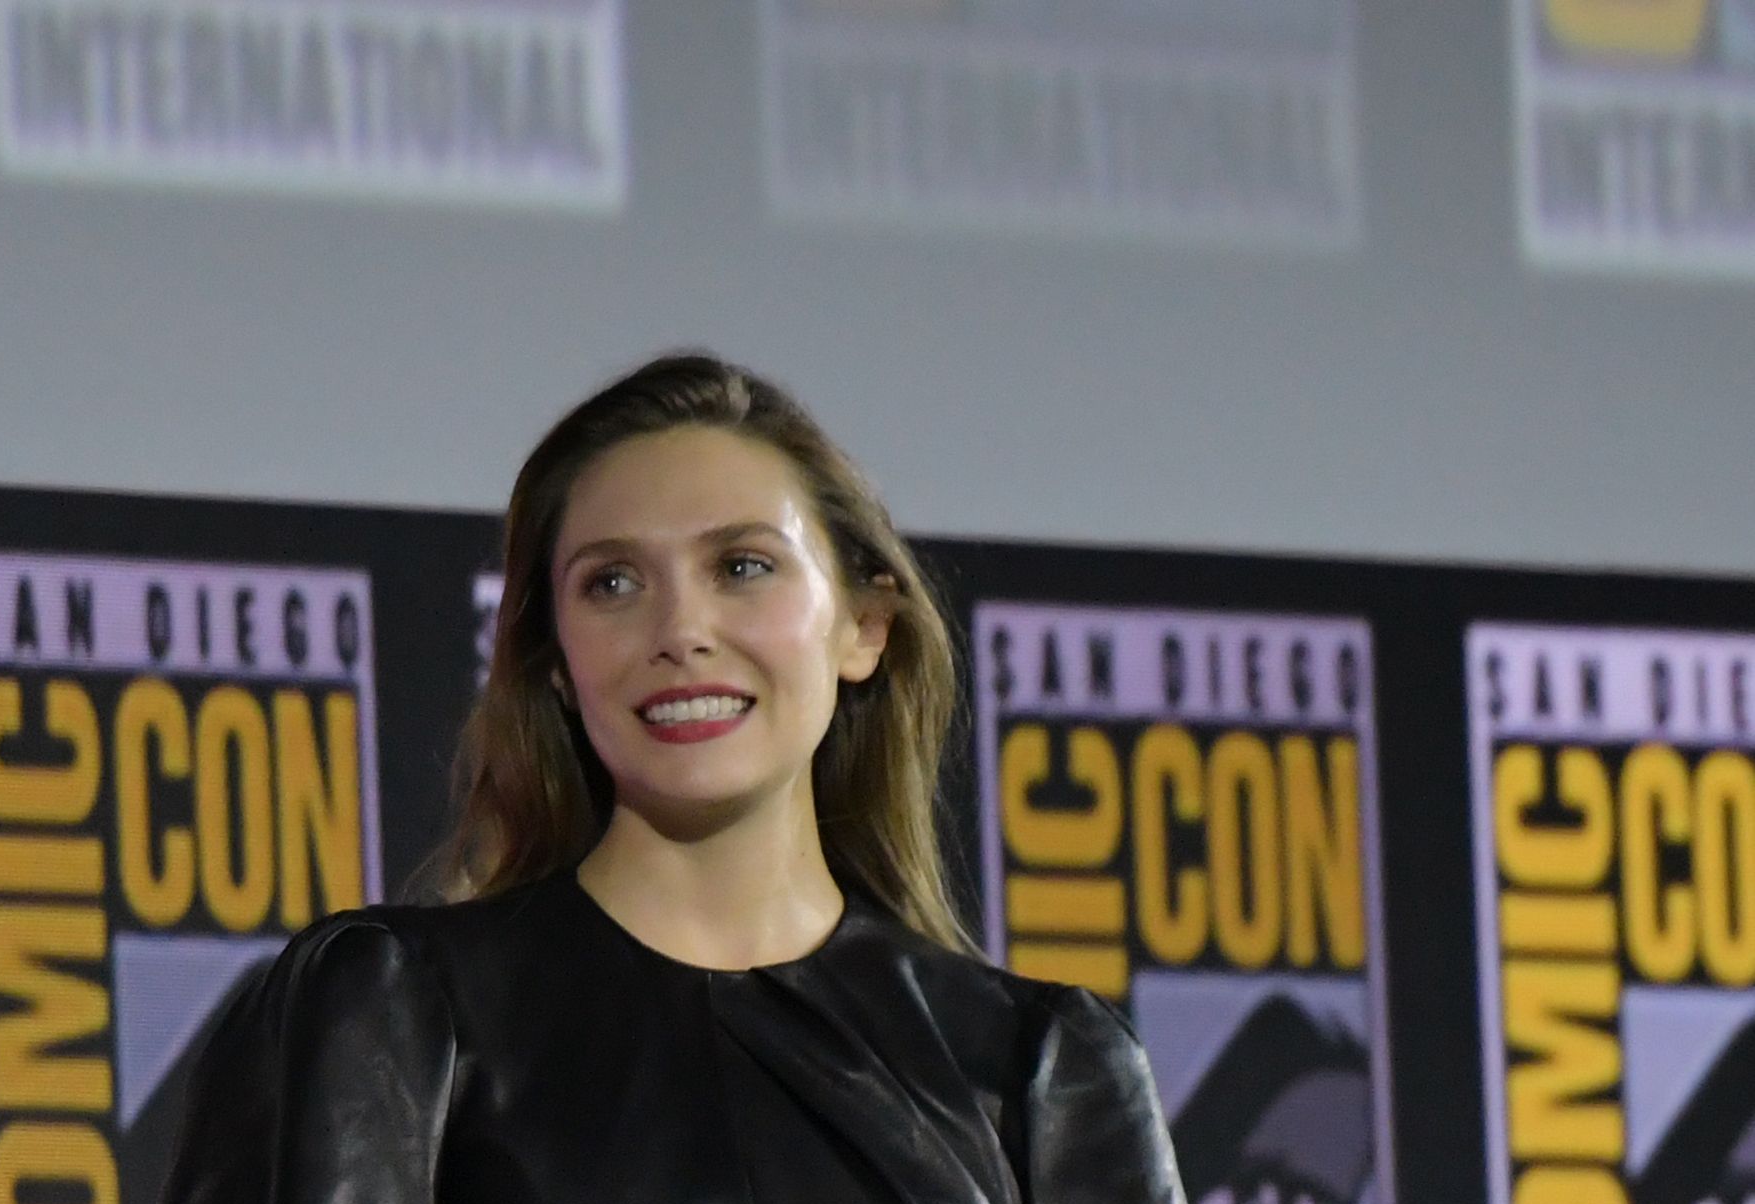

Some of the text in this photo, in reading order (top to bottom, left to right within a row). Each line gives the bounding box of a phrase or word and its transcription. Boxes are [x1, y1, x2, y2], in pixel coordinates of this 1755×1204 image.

[146, 583, 360, 668] DIEGO
[989, 623, 1360, 715] SAN DIEGO
[1485, 650, 1748, 734] SAN DIE
[113, 676, 365, 932] CON
[1130, 722, 1366, 970] CON
[1619, 740, 1755, 985] CO
